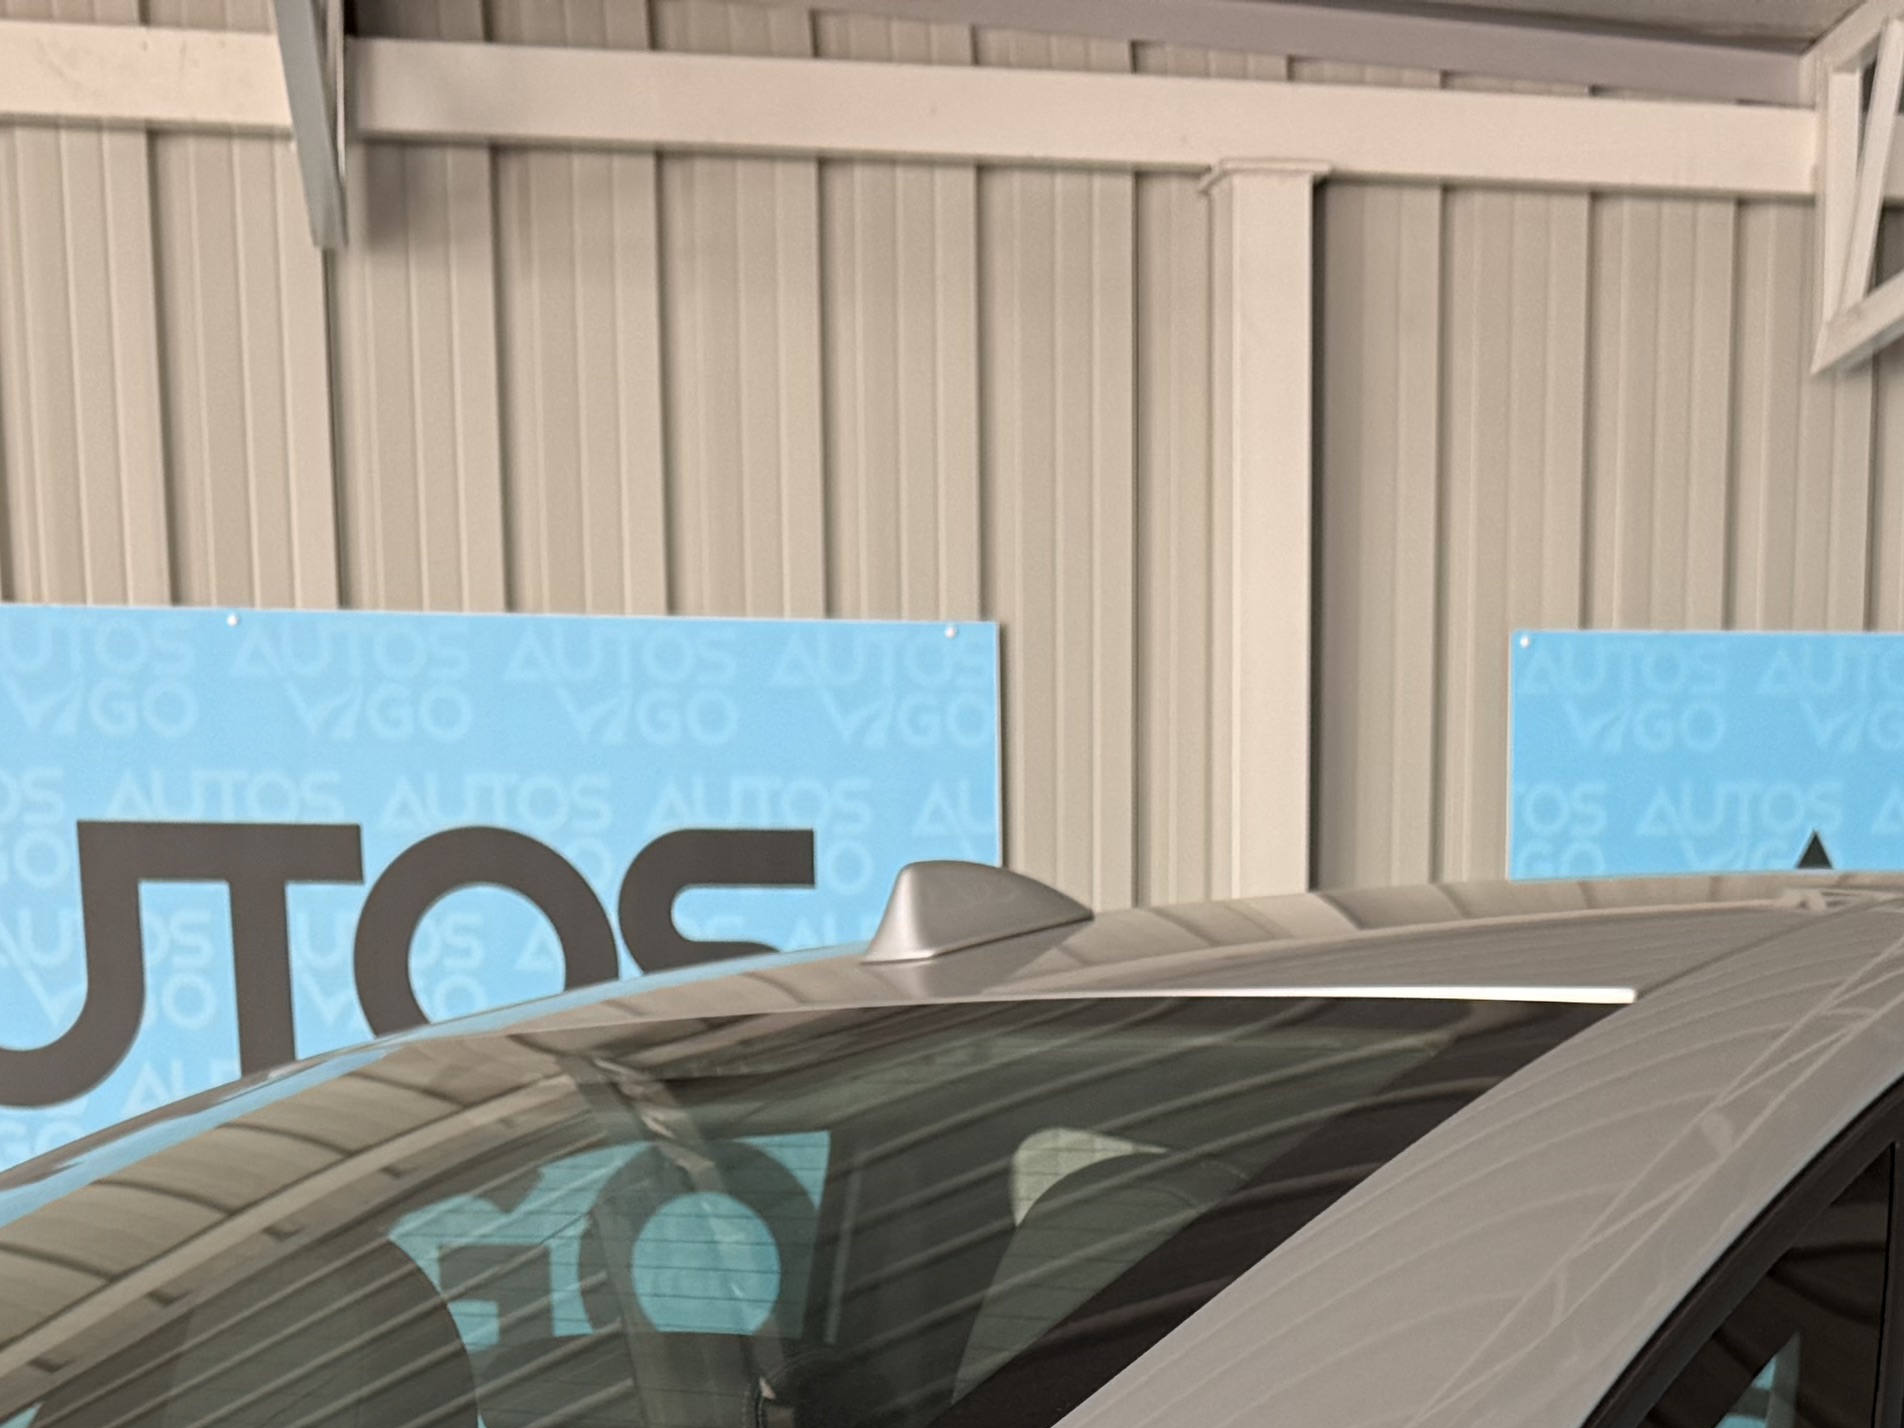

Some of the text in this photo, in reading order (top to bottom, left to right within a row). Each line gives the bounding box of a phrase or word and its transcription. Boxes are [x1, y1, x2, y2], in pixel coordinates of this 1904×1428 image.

[228, 617, 470, 679] AUTOS
[502, 624, 736, 685] AUTOS
[770, 629, 992, 689] AUTOS
[1516, 642, 1729, 694] AUTOS
[1636, 781, 1845, 837] AUTOS
